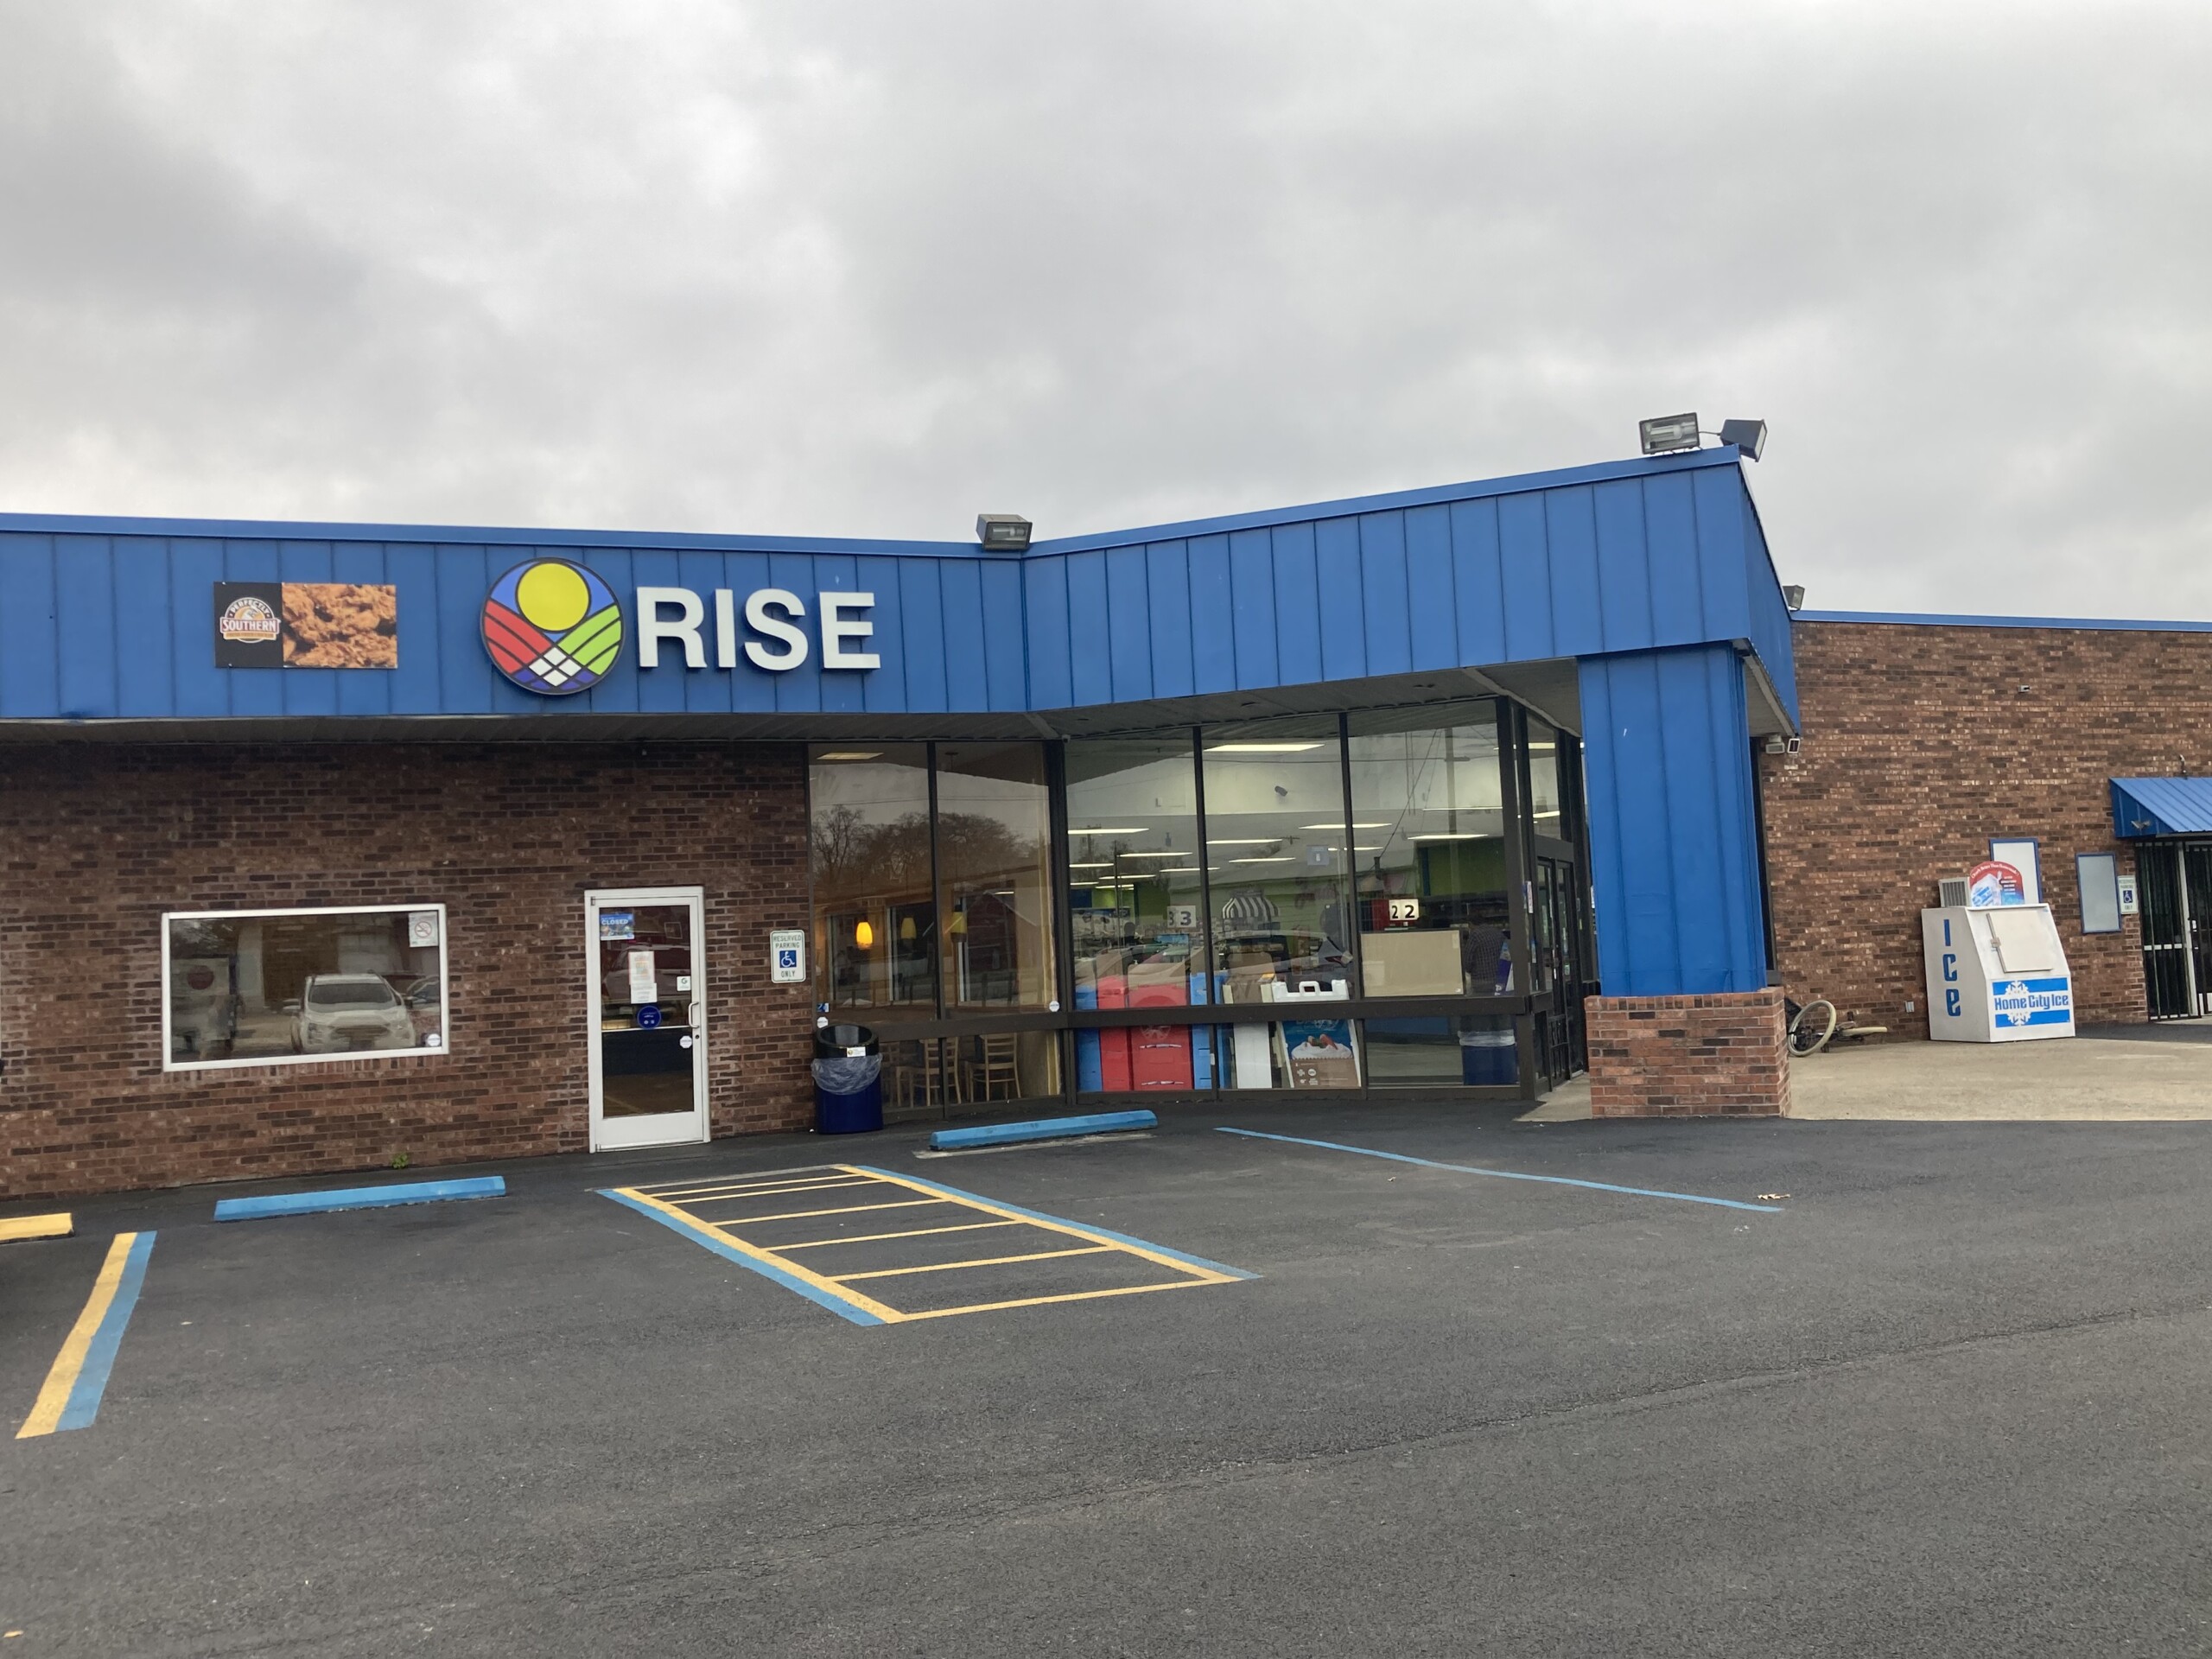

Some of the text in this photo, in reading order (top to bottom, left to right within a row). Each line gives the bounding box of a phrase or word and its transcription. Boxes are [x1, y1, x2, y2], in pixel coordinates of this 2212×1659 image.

[230, 600, 270, 613] PERFECTLY
[222, 620, 276, 632] SOUTHERN
[636, 587, 880, 671] RISE
[1180, 911, 1192, 925] 3
[1404, 905, 1415, 918] 2
[1994, 995, 2069, 1011] Home City Ice
